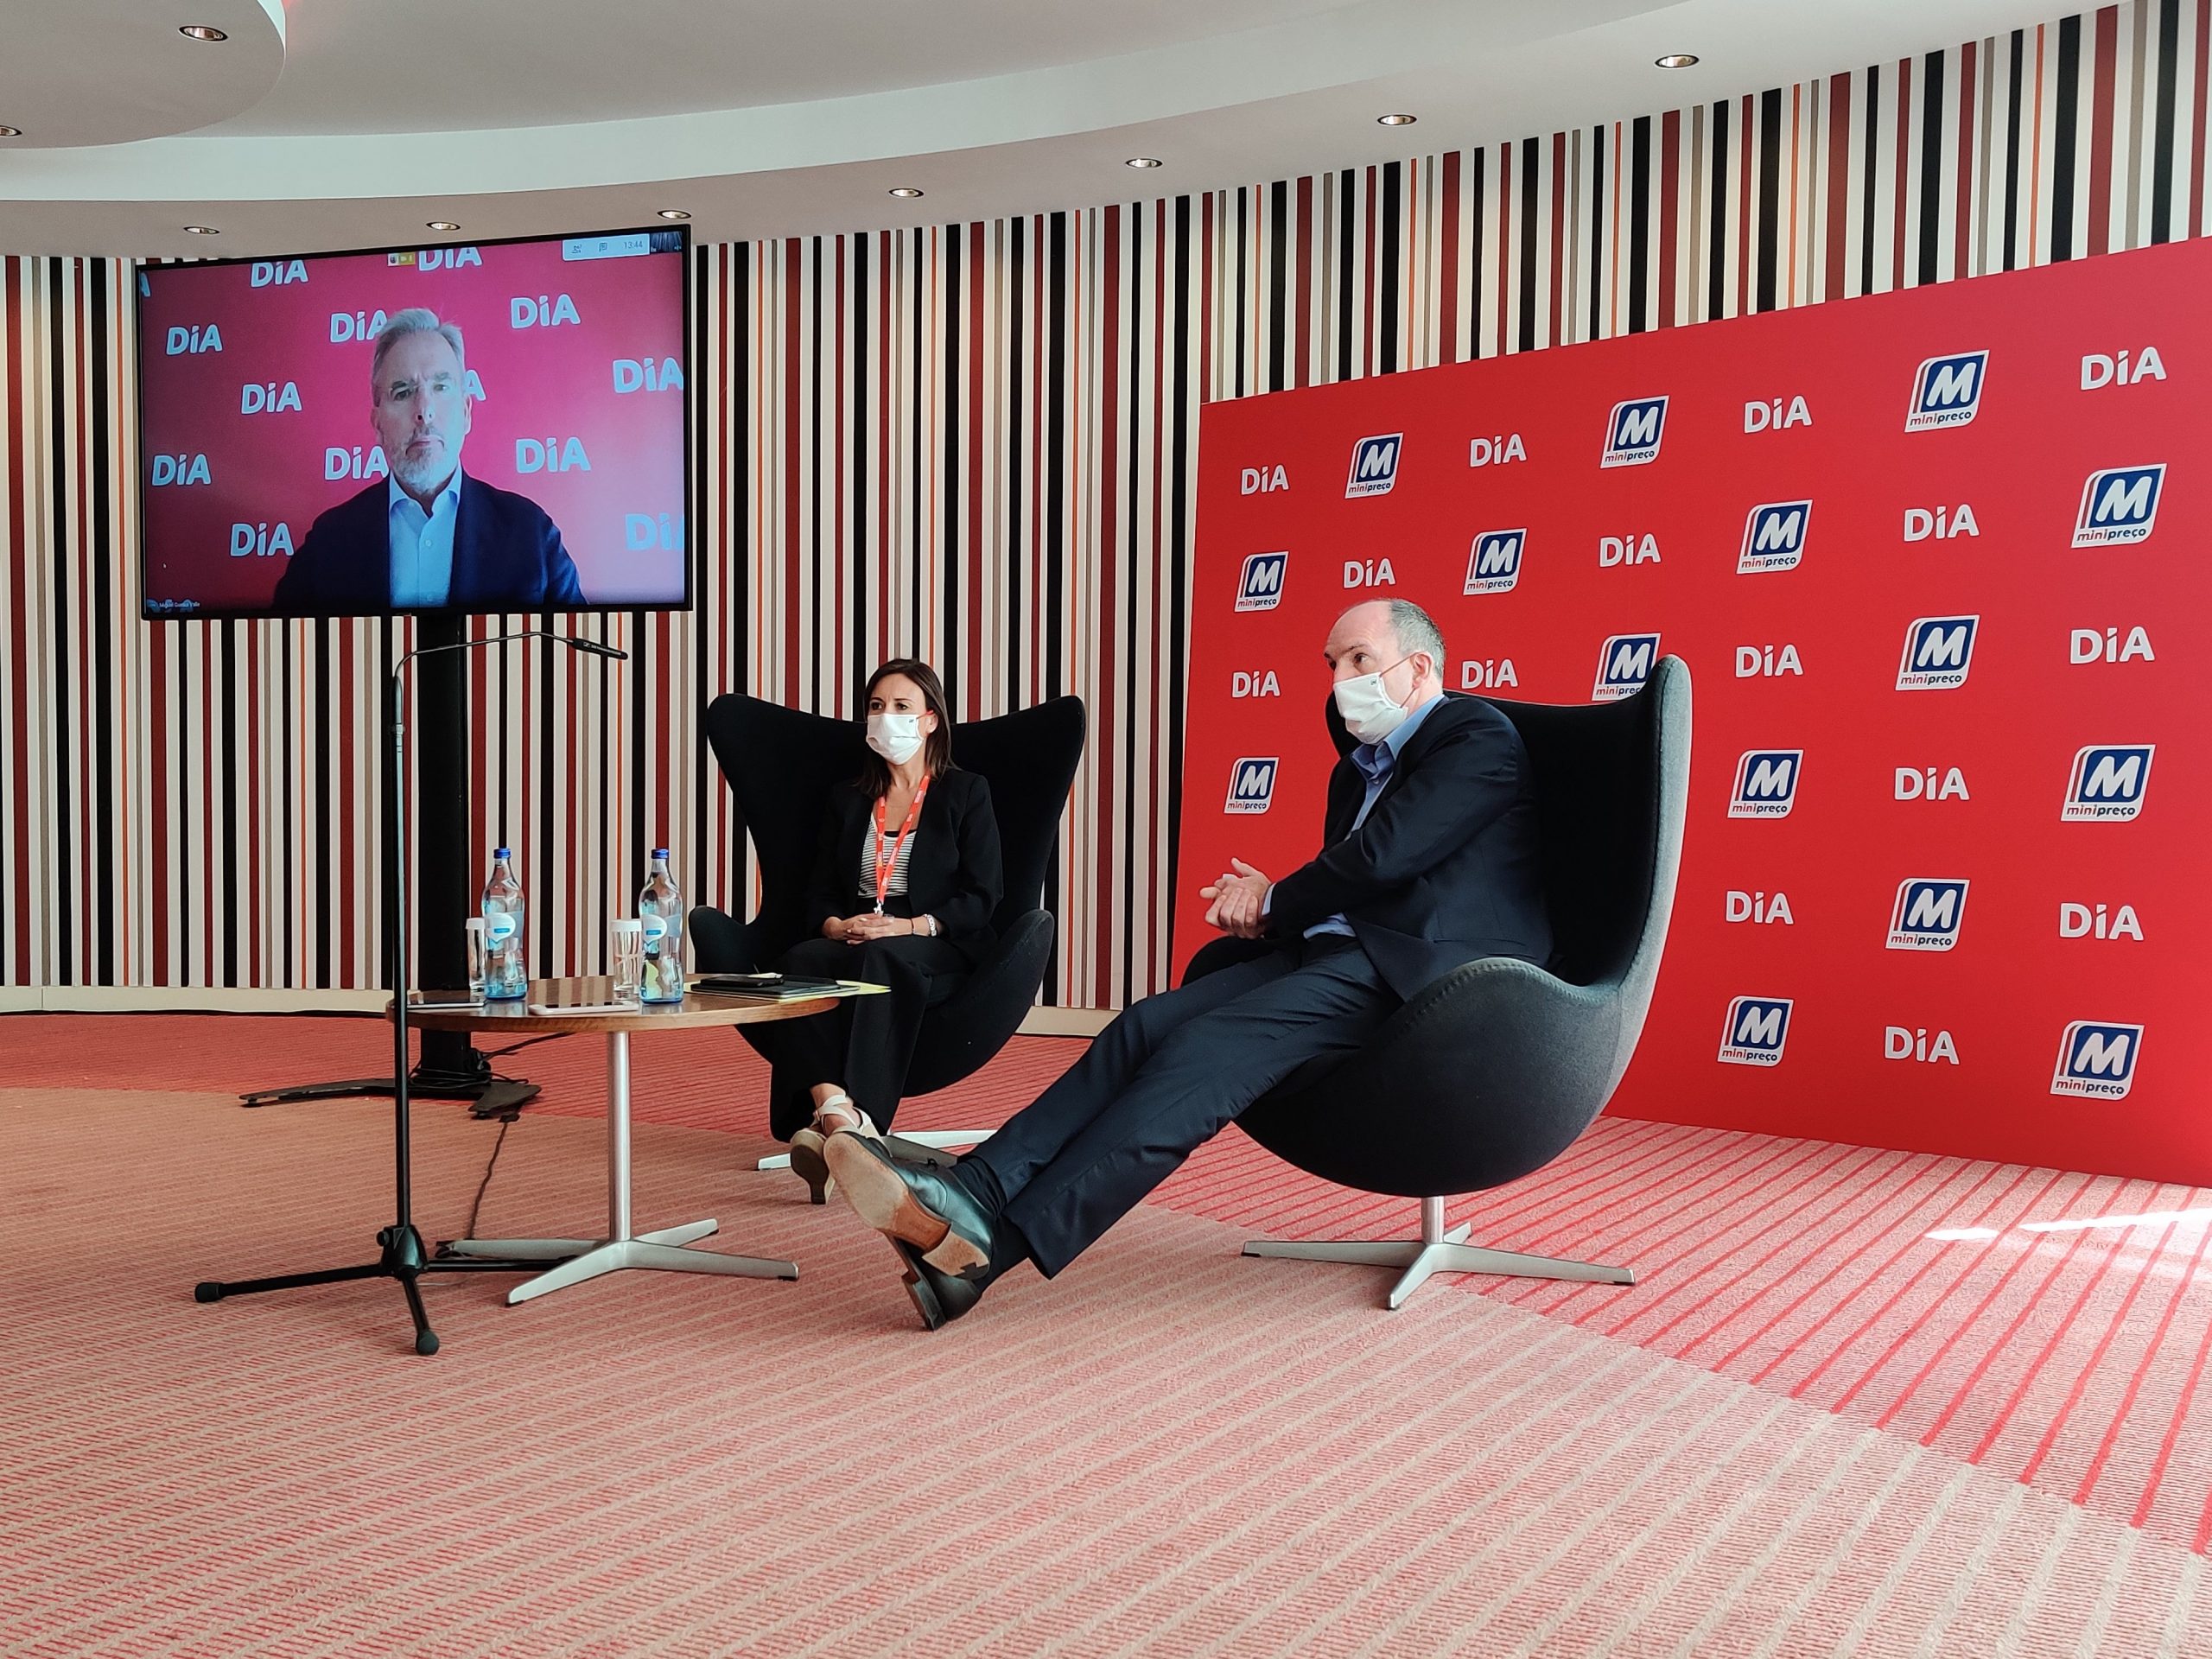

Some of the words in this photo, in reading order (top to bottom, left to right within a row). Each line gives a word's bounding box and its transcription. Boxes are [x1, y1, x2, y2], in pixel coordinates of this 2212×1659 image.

[623, 240, 644, 250] 13:44
[512, 294, 580, 329] DiA
[166, 325, 223, 356] DiA
[1927, 363, 1976, 406] M
[2081, 346, 2167, 391] DiA
[241, 382, 302, 415] DiA
[1744, 395, 1813, 434] DiA
[1618, 407, 1658, 445] M
[1909, 410, 1973, 428] minipreço
[325, 446, 391, 483] DiA
[515, 436, 591, 473] DiA
[1360, 442, 1394, 477] M
[1471, 433, 1527, 467] DiA
[1604, 448, 1656, 463] minipreço
[151, 453, 212, 486] DiA
[1241, 464, 1289, 495] DiA
[1348, 480, 1391, 495] minipreço
[2095, 476, 2152, 522] M
[230, 523, 295, 556] DiA
[1756, 512, 1801, 550] M
[1904, 504, 1980, 542] DiA
[2076, 528, 2147, 542] minipreço
[1479, 538, 1516, 574] M
[1599, 533, 1662, 568] DiA
[1741, 556, 1797, 569] minipreço
[1249, 561, 1280, 594] M
[1344, 557, 1395, 588] DiA
[1466, 578, 1513, 592] minipreço
[1236, 597, 1278, 609] minipreço
[1610, 644, 1650, 679] M
[1735, 644, 1803, 678] DiA
[1917, 626, 1967, 666] M
[2069, 626, 2155, 664] DiA
[1232, 671, 1281, 698] DiA
[1461, 658, 1518, 690] DiA
[1900, 673, 1962, 686] minipreço
[1238, 765, 1271, 797] M
[1747, 760, 1791, 797] M
[1894, 767, 1970, 801] DiA
[2085, 756, 2140, 797] M
[1227, 800, 1268, 810] minipreço
[1731, 803, 1788, 815] minipreço
[2065, 804, 2136, 817] minipreço
[1726, 891, 1794, 925] DiA
[1907, 888, 1956, 928] M
[2059, 902, 2144, 941] DiA
[1890, 933, 1952, 947] minipreço
[1738, 1007, 1782, 1045] M
[1721, 1048, 1778, 1063] minipreço
[1885, 1026, 1960, 1065] DiA
[2075, 1033, 2129, 1075] M
[2055, 1078, 2125, 1096] minipreço
